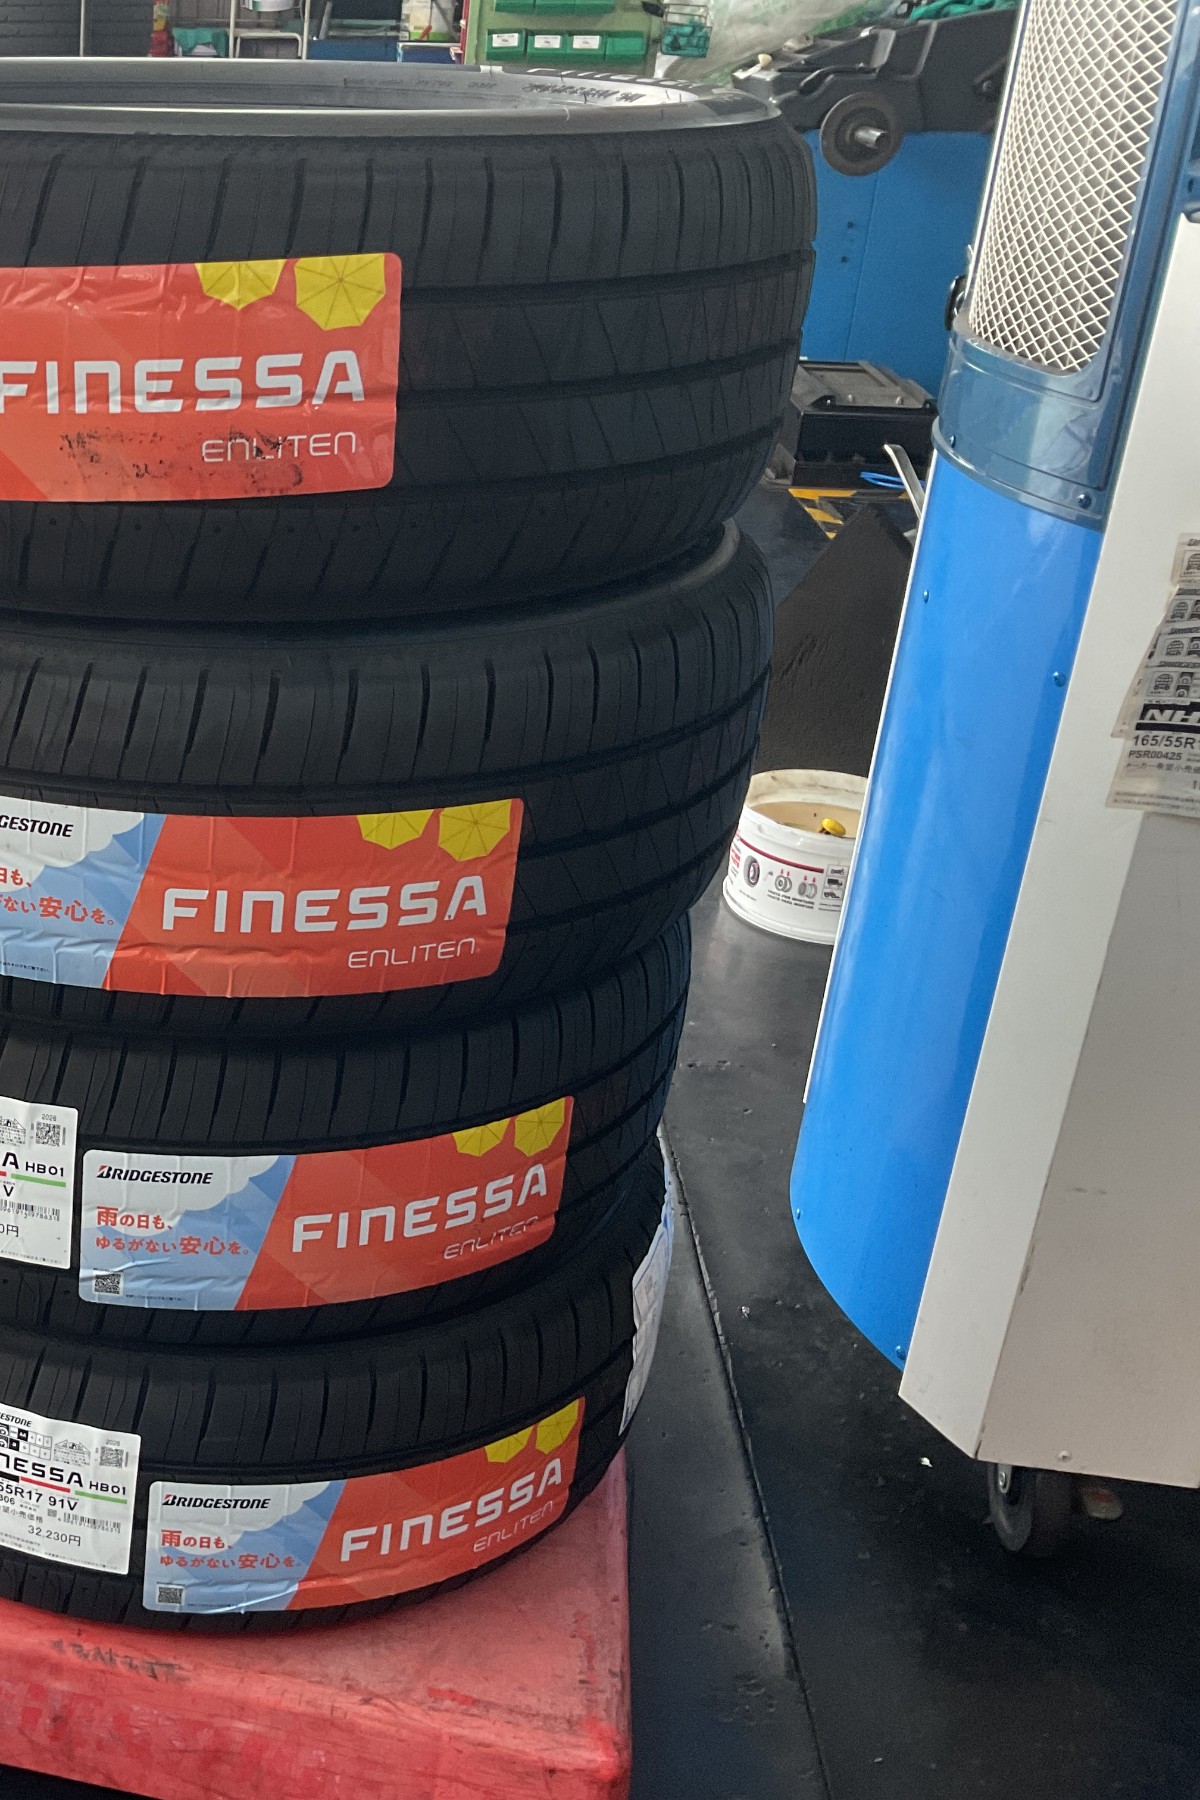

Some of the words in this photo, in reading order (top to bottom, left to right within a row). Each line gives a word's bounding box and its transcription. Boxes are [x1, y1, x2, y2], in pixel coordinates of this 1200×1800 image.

[202, 431, 357, 463] ENLITEN
[1133, 734, 1200, 749] 165/55R
[162, 875, 487, 933] FINESSA
[347, 937, 476, 969] ENLITEN
[25, 1161, 65, 1177] HB01
[97, 1165, 213, 1184] BRIDGESTONE
[96, 1205, 173, 1230] 雨の日も、
[291, 1163, 548, 1253] FINESSA
[95, 1235, 249, 1256] ゆるがない安心を。
[89, 1481, 127, 1496] HB01
[48, 1495, 78, 1511] 91V
[162, 1494, 271, 1509] BRIDGESTONE
[340, 1458, 562, 1563] FINESSA
[473, 1500, 554, 1553] ENLITEN
[161, 1529, 233, 1549] 雨の日も、
